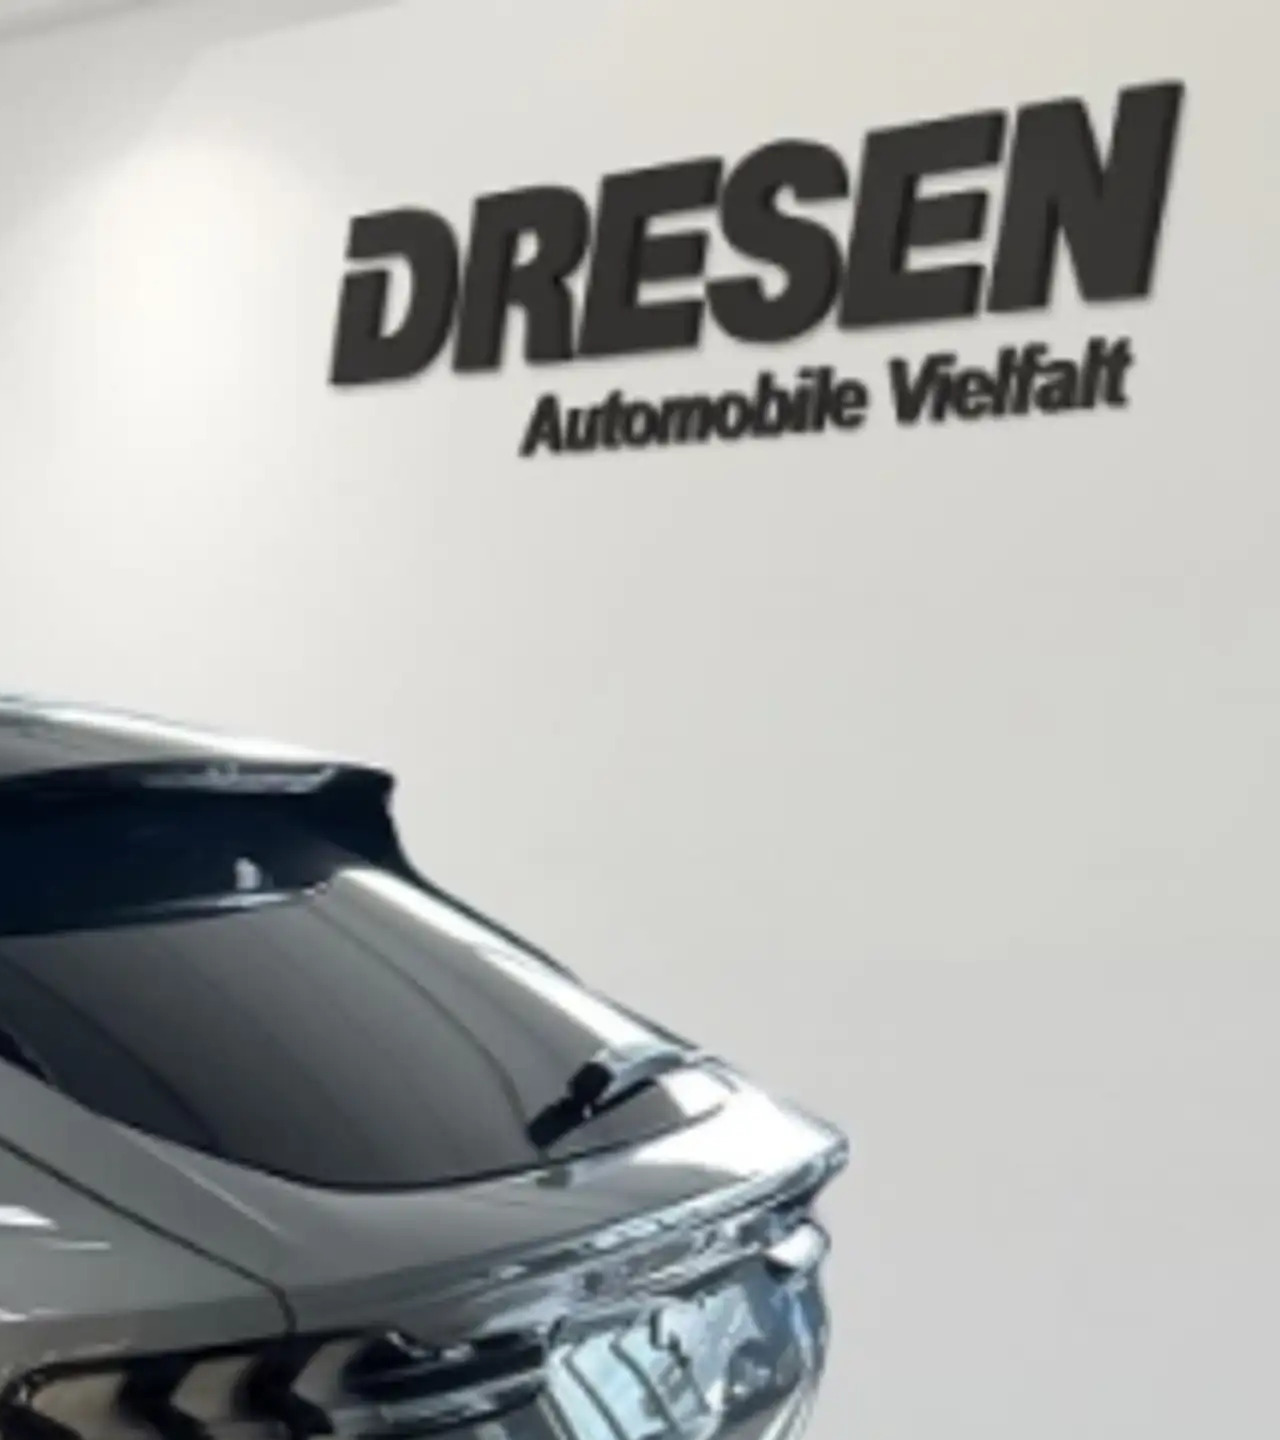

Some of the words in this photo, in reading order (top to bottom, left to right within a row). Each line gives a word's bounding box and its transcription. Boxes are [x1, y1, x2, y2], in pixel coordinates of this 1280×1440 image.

[329, 81, 1184, 386] DRESEN
[519, 365, 870, 458] Automobile
[887, 336, 1134, 426] Vielfalt
